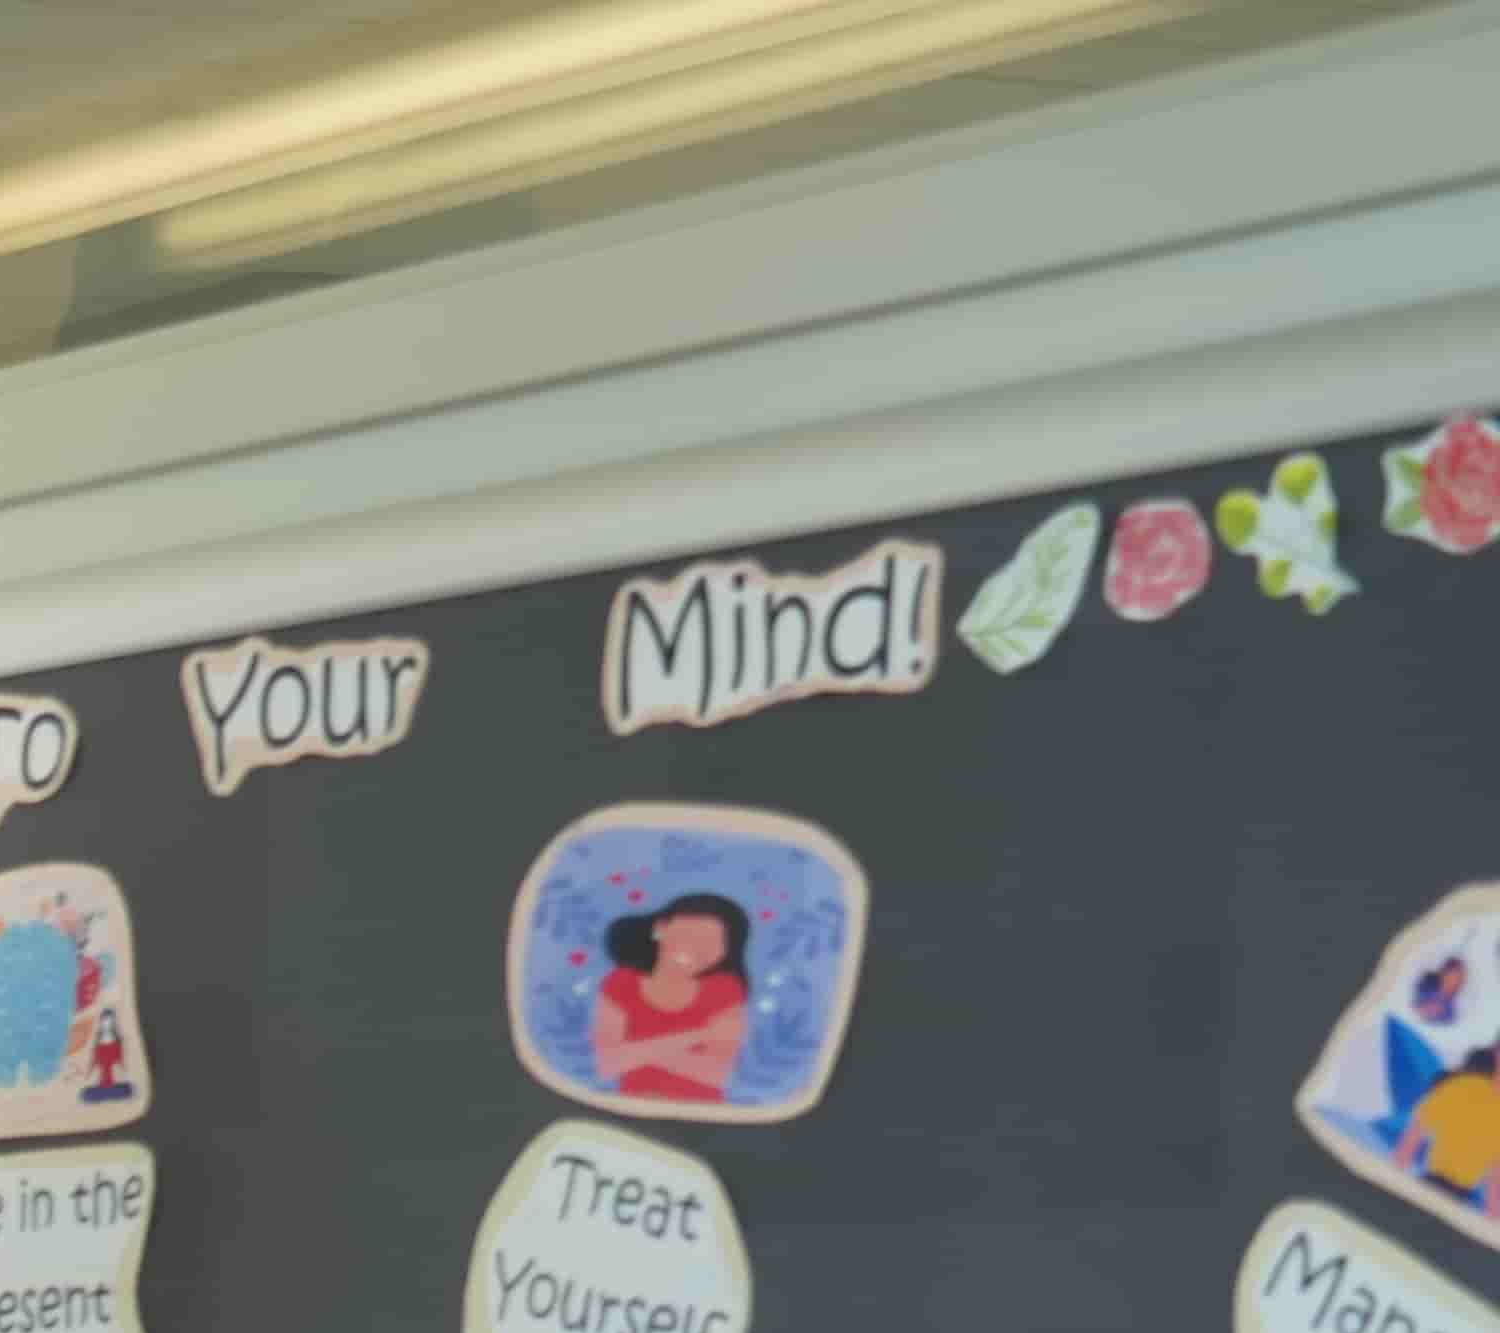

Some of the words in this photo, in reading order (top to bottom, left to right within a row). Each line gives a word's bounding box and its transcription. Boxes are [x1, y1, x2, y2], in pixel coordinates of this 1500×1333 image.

[197, 652, 418, 784] Your
[617, 572, 929, 719] Mind!
[19, 1178, 55, 1233] in
[70, 1171, 144, 1229] the
[552, 1153, 704, 1242] Treat
